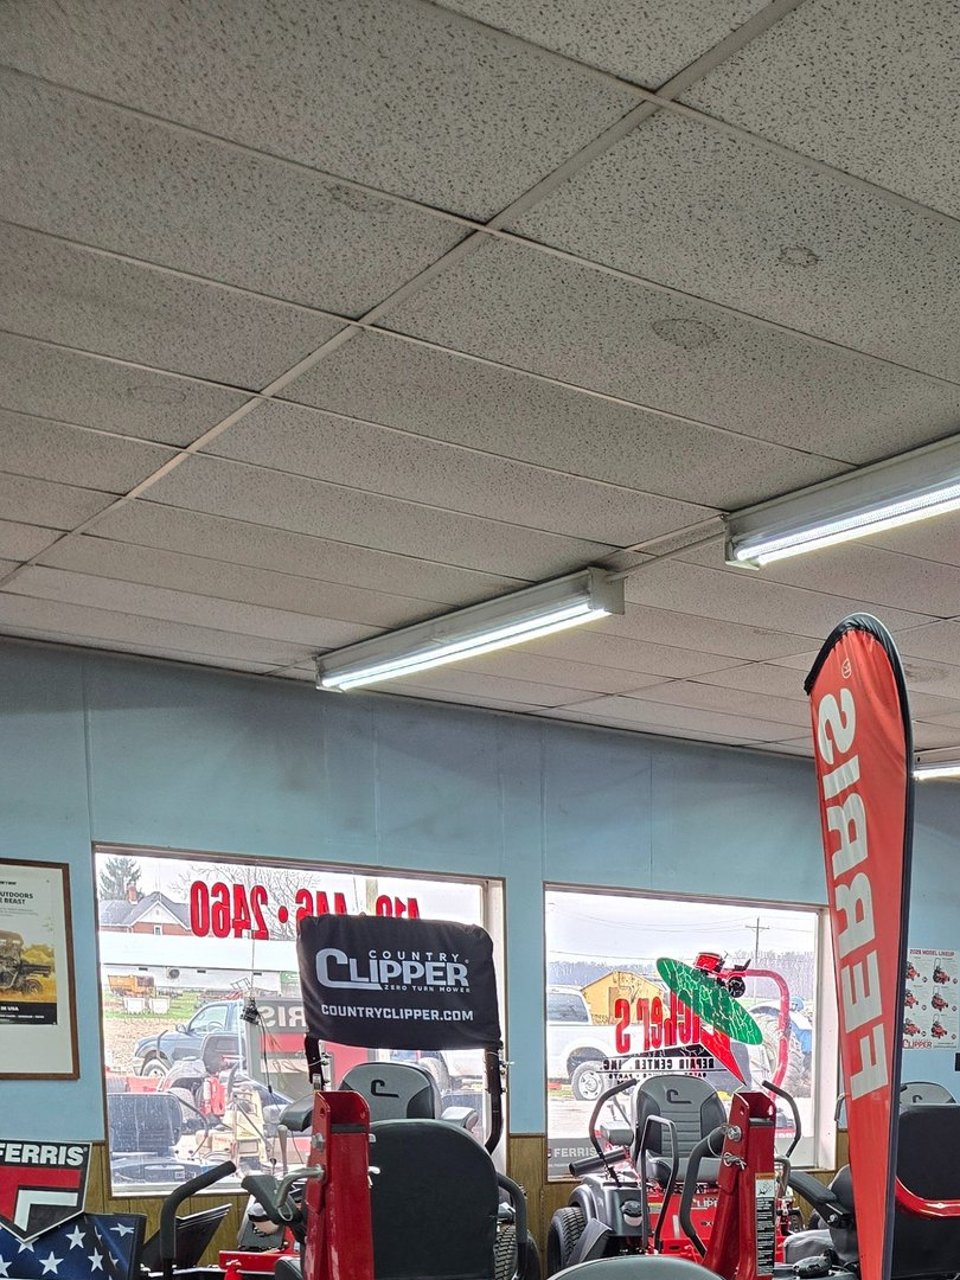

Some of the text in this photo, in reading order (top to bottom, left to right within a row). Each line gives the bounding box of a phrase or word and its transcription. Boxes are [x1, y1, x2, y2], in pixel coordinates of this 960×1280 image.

[368, 950, 460, 963] COUNTRY
[315, 947, 469, 991] CLIPPER
[321, 1004, 474, 1021] COUNTRYCLIPPER.COM
[554, 1147, 598, 1157] FERRIS
